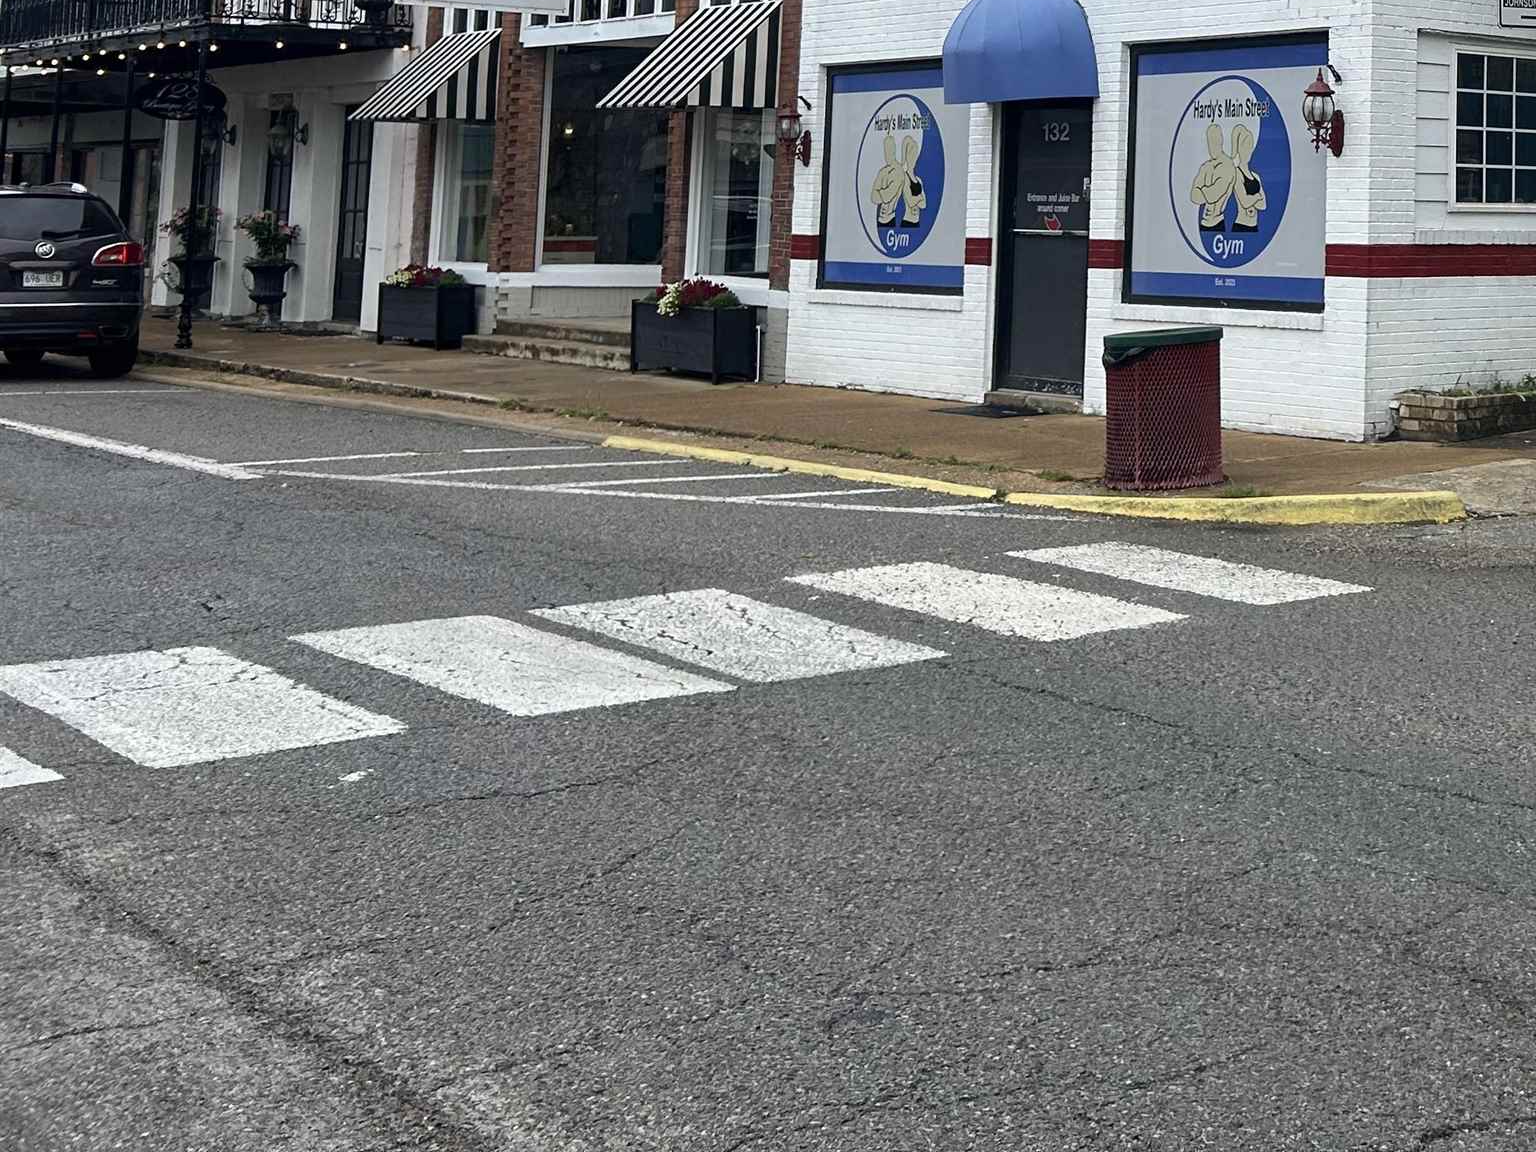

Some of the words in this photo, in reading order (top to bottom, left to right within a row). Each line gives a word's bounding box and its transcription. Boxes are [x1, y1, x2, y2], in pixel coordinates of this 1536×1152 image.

[1193, 99, 1223, 122] Hardy's
[1224, 98, 1244, 117] Main
[1245, 97, 1270, 117] Street
[1042, 122, 1070, 142] 132
[886, 229, 910, 251] Gym
[1212, 234, 1244, 259] Gym
